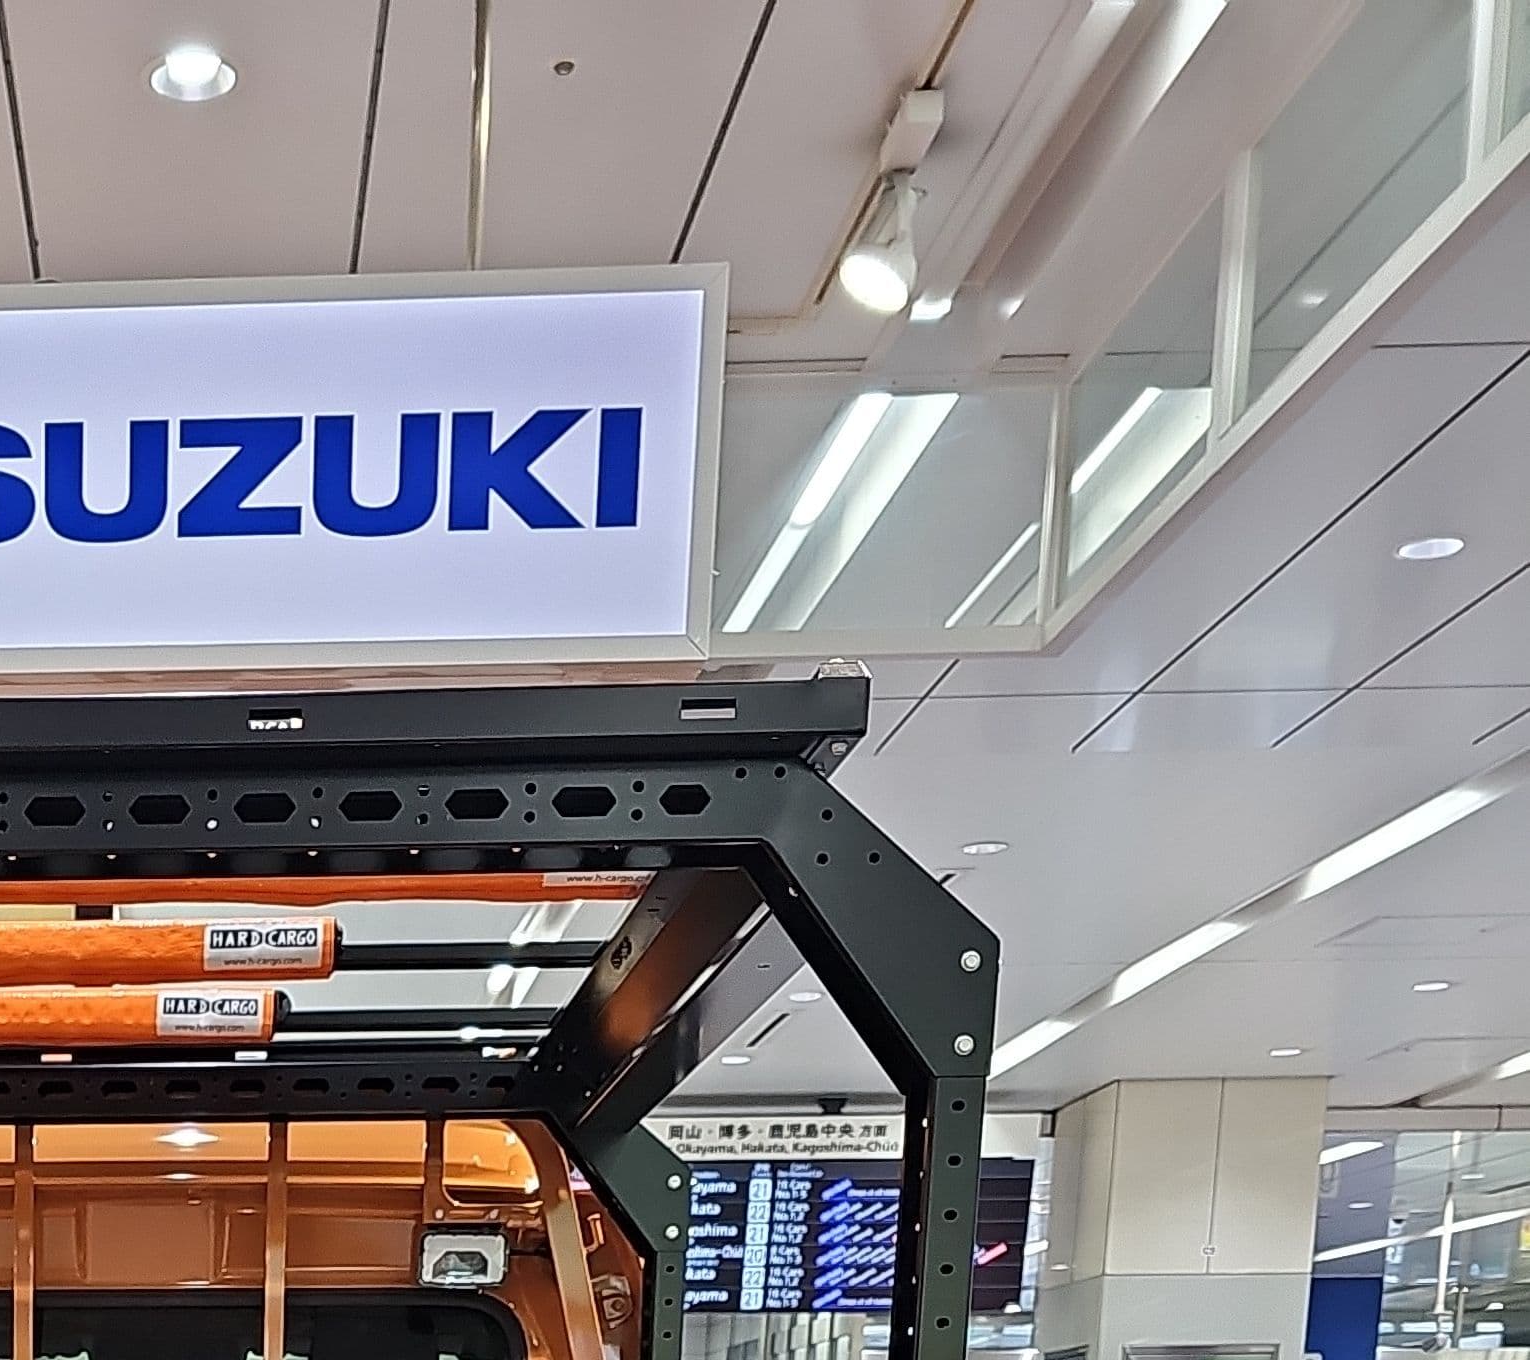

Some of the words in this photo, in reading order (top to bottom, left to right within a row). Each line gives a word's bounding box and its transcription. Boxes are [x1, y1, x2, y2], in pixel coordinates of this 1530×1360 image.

[566, 874, 650, 883] www.h-cargo.c
[213, 931, 261, 947] HARD
[267, 929, 316, 946] CARGO
[223, 957, 303, 967] www.h-cargo.com
[165, 1000, 208, 1014] HARD
[213, 999, 257, 1014] CARGO
[174, 1023, 245, 1033] www.h-cargo.com
[676, 1143, 739, 1155] Okayama,
[741, 1143, 788, 1154] Hakata,
[691, 1182, 737, 1197] ayama
[752, 1183, 768, 1198] 21
[690, 1202, 721, 1216] kata
[750, 1205, 768, 1219] 22
[749, 1226, 764, 1240] 21
[685, 1267, 717, 1280] kata
[745, 1271, 762, 1286] 22
[685, 1290, 729, 1306] ayama
[744, 1292, 760, 1307] 21
